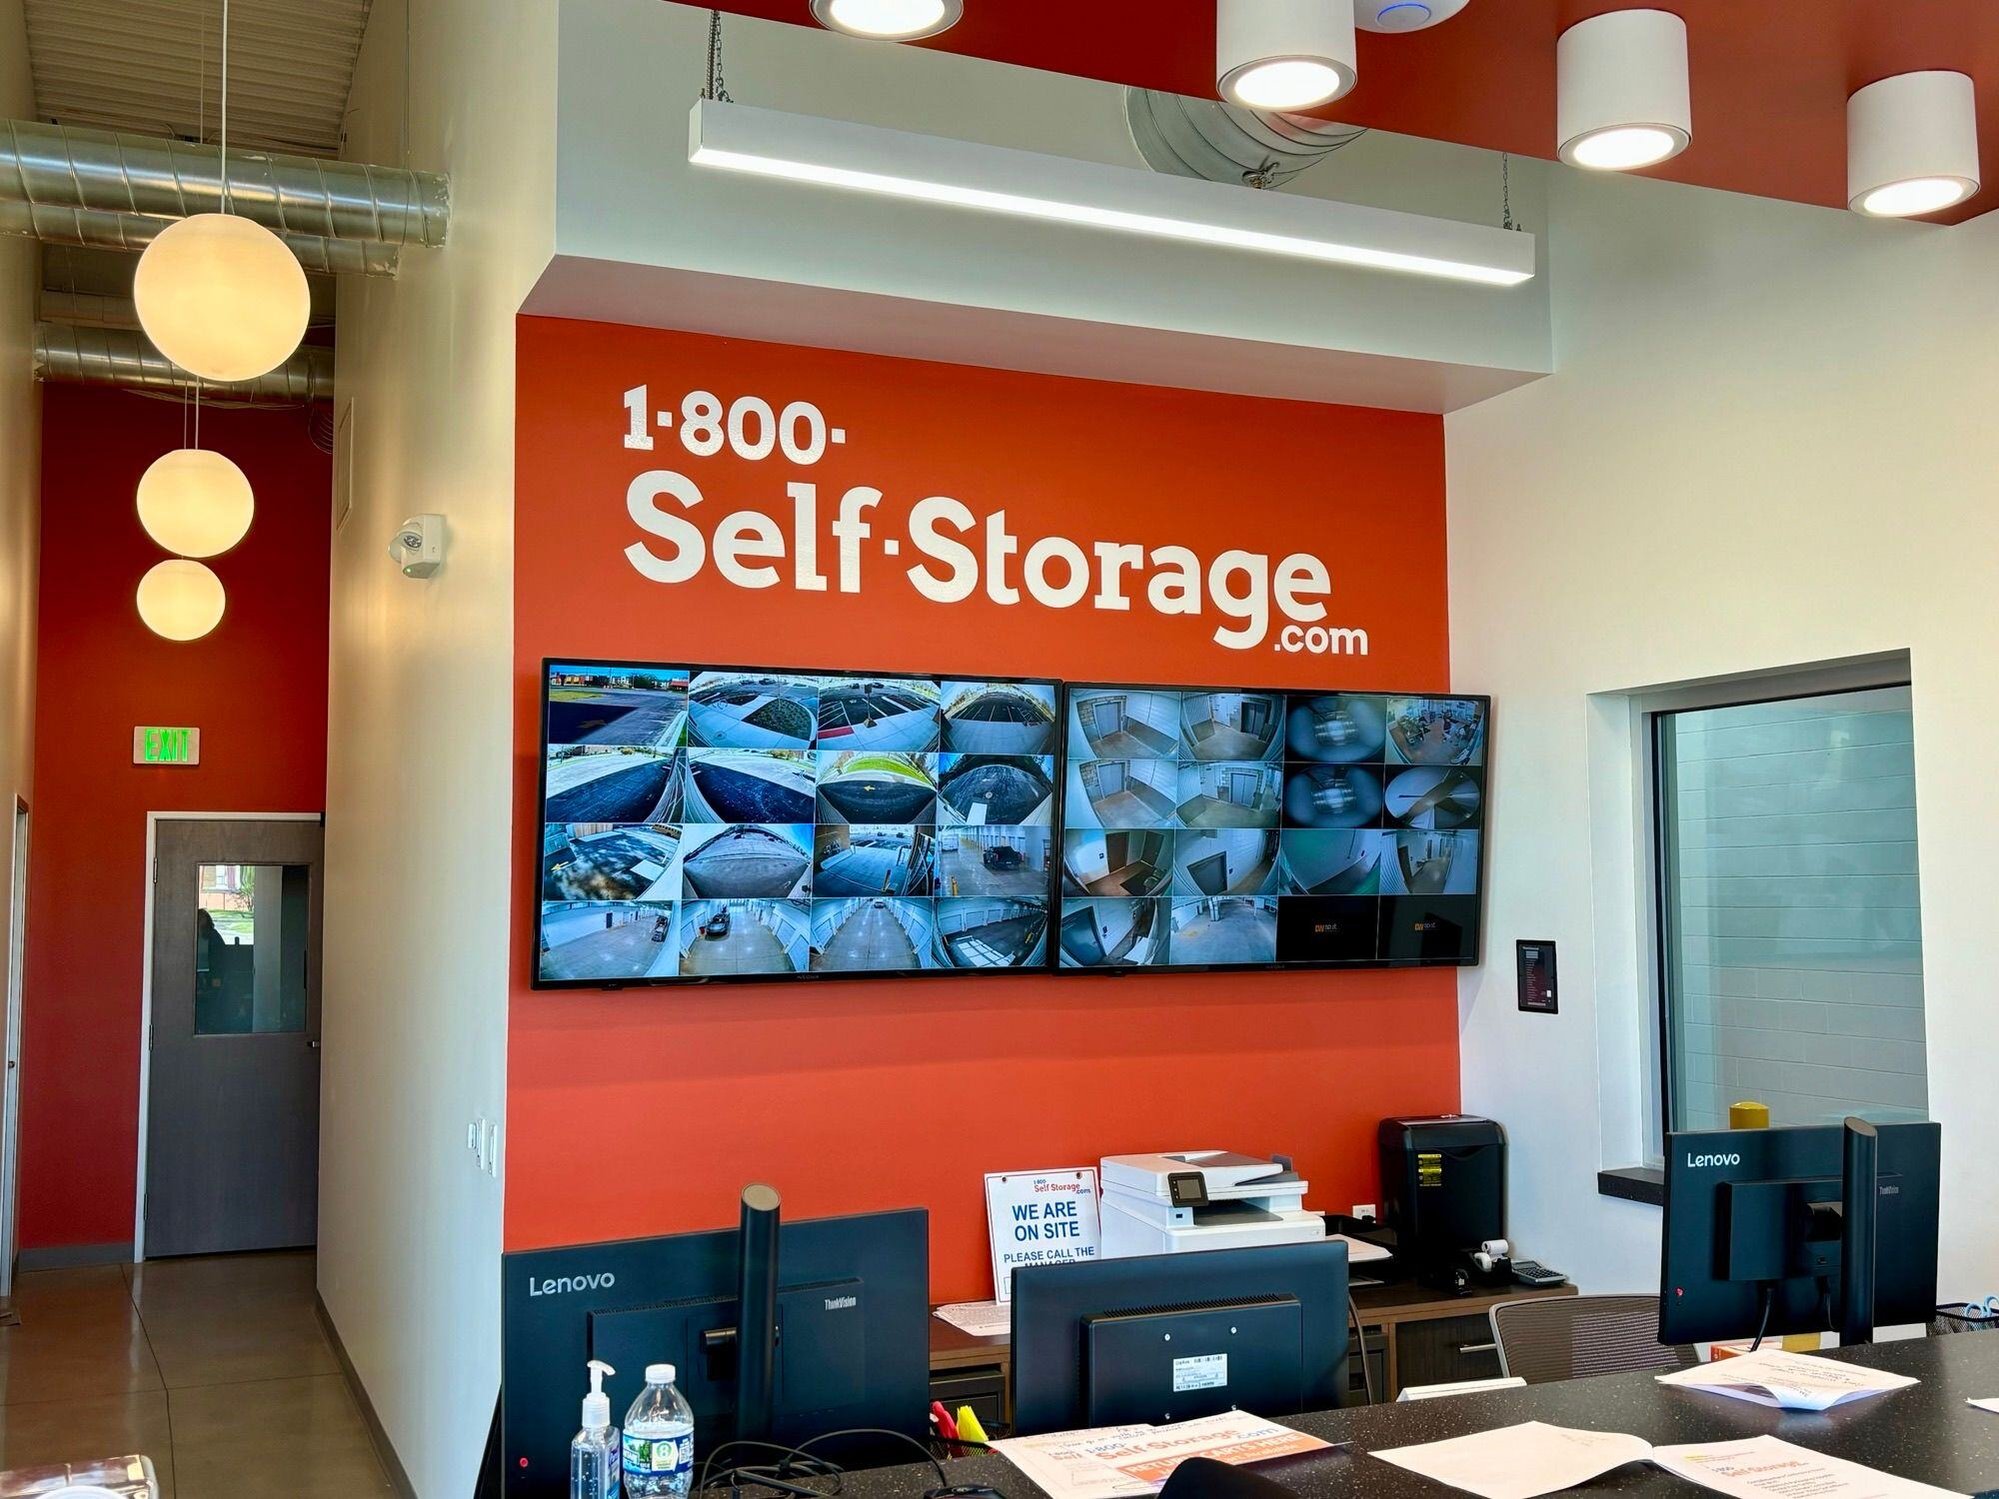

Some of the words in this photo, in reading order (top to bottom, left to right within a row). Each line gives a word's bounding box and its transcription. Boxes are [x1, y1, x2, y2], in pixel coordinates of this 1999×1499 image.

[1274, 624, 1368, 656] .com
[145, 729, 191, 761] EXIT
[1687, 1152, 1741, 1168] Lenovo
[1050, 1183, 1081, 1192] Storage
[1012, 1204, 1039, 1221] WE
[1043, 1201, 1077, 1219] ARE
[1015, 1224, 1039, 1242] ON
[1044, 1221, 1080, 1239] SITE
[1003, 1251, 1044, 1263] PLEASE
[1046, 1248, 1073, 1259] CALL
[1074, 1246, 1095, 1257] THE
[529, 1272, 615, 1297] Lenovo
